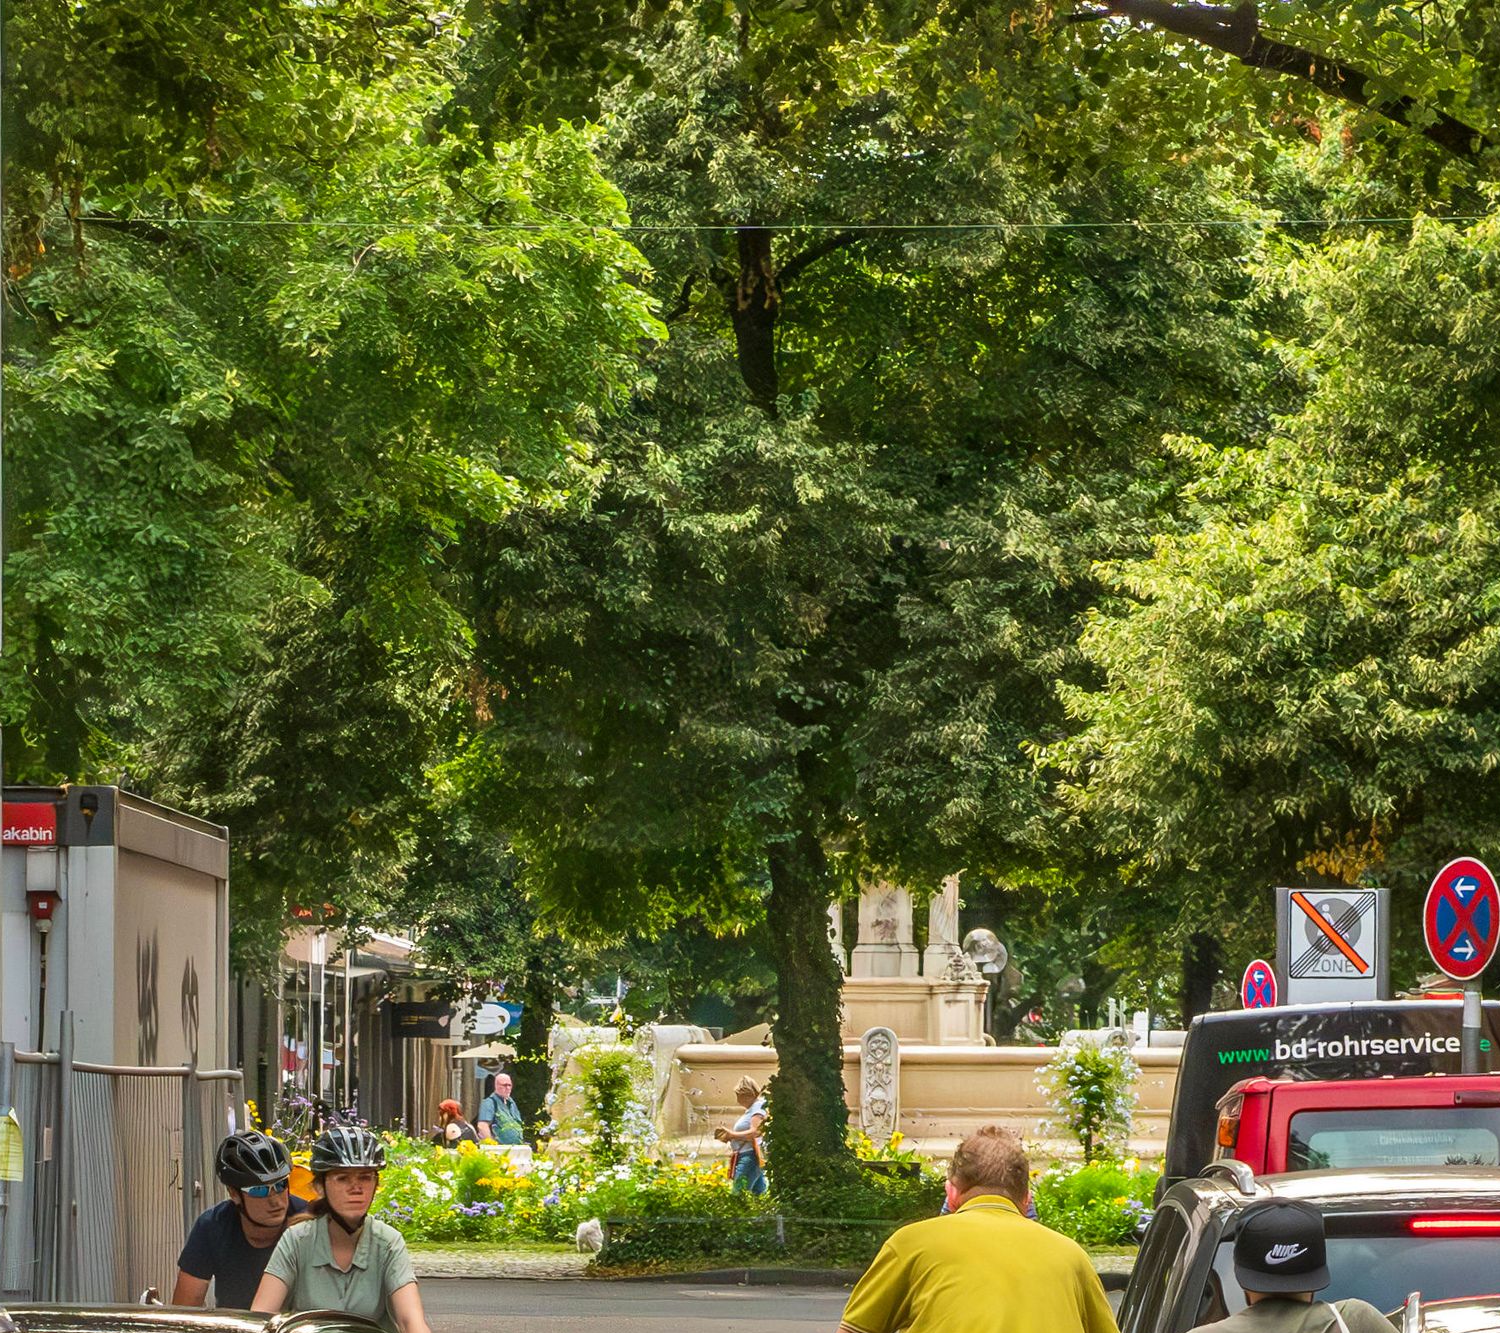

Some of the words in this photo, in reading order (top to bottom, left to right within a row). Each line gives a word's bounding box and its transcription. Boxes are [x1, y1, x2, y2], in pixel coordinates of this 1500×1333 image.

[2, 826, 53, 841] akabin
[1312, 959, 1353, 973] ZONE
[1218, 1033, 1492, 1065] www.bd-rohrservicee
[1271, 1243, 1299, 1257] NIKE
